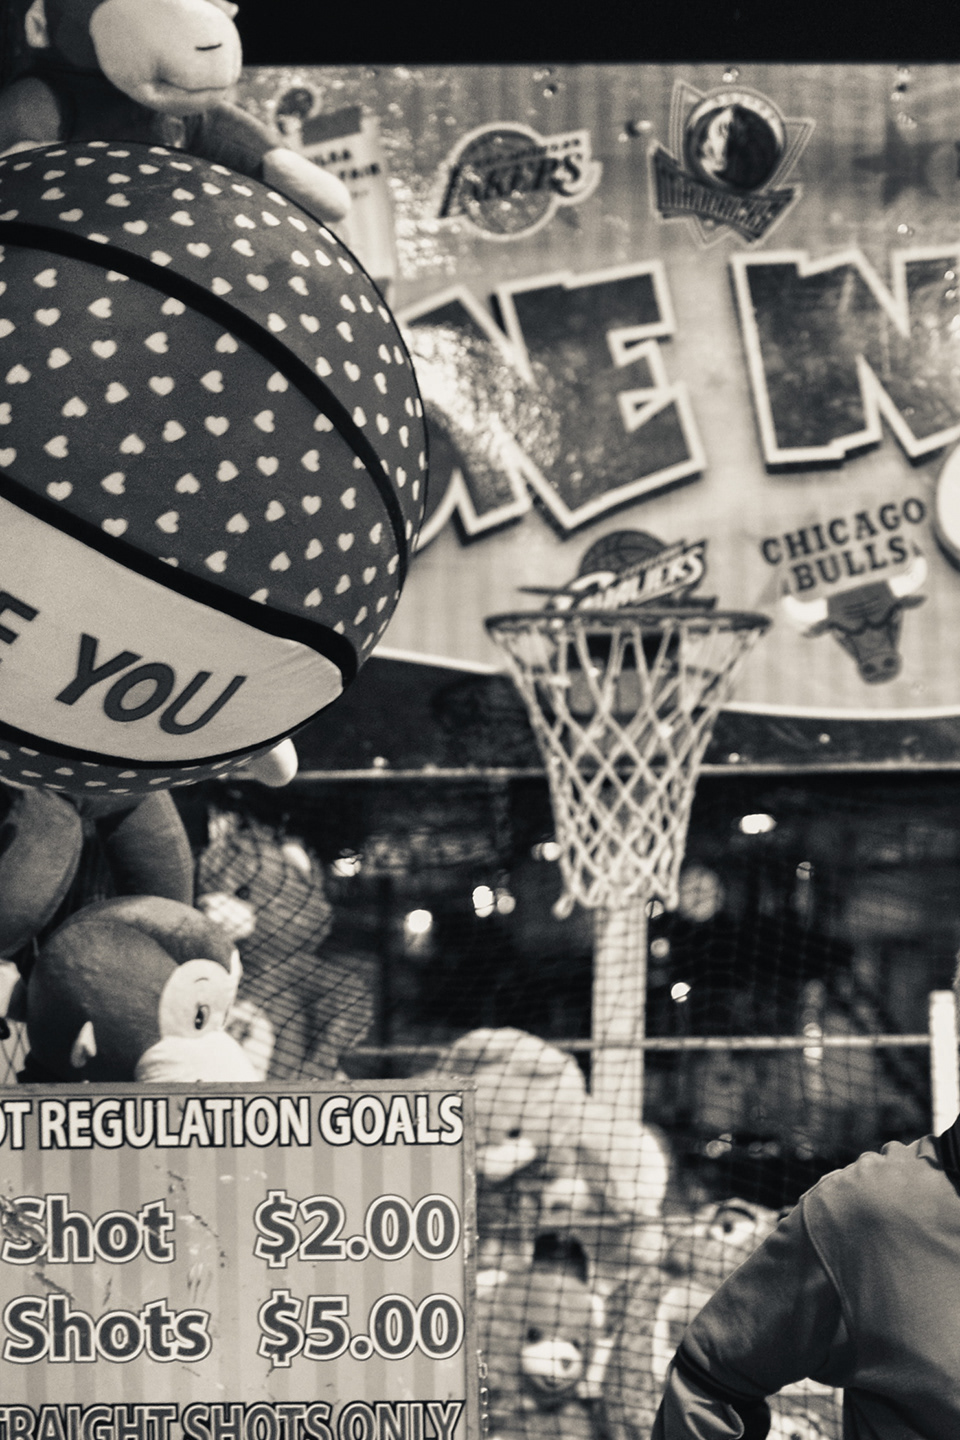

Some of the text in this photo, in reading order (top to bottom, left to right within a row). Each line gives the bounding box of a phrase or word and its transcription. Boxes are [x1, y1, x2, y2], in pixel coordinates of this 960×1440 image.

[396, 259, 708, 546] NE
[761, 498, 927, 567] CHICAGO
[791, 535, 908, 592] BULLS
[55, 632, 248, 735] YOU
[0, 1095, 464, 1150] T REGULATION GOALS
[1, 1189, 462, 1269] Shot $2.00
[2, 1289, 466, 1368] Shots $5.00
